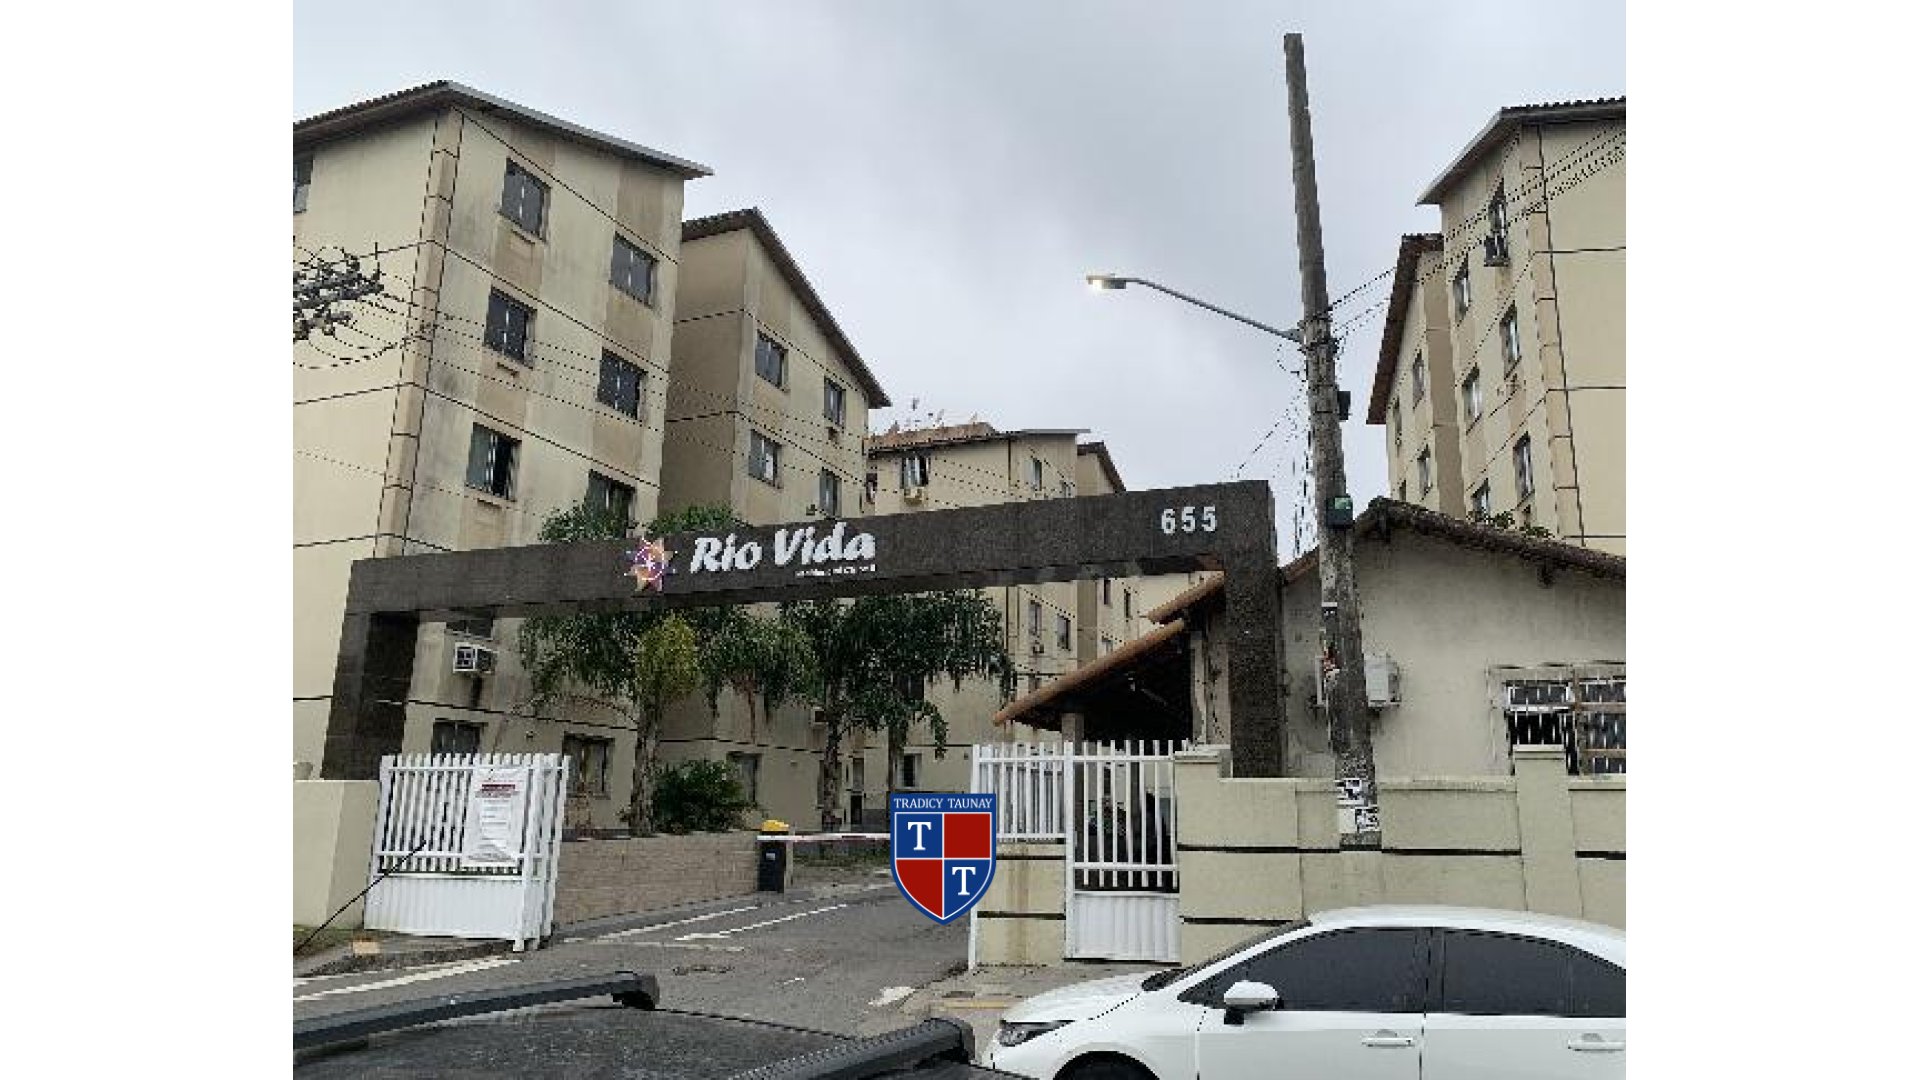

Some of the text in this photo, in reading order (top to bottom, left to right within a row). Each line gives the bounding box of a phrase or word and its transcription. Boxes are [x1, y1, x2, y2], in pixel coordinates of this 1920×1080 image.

[1161, 505, 1217, 534] 655
[690, 521, 876, 574] Rio Vida
